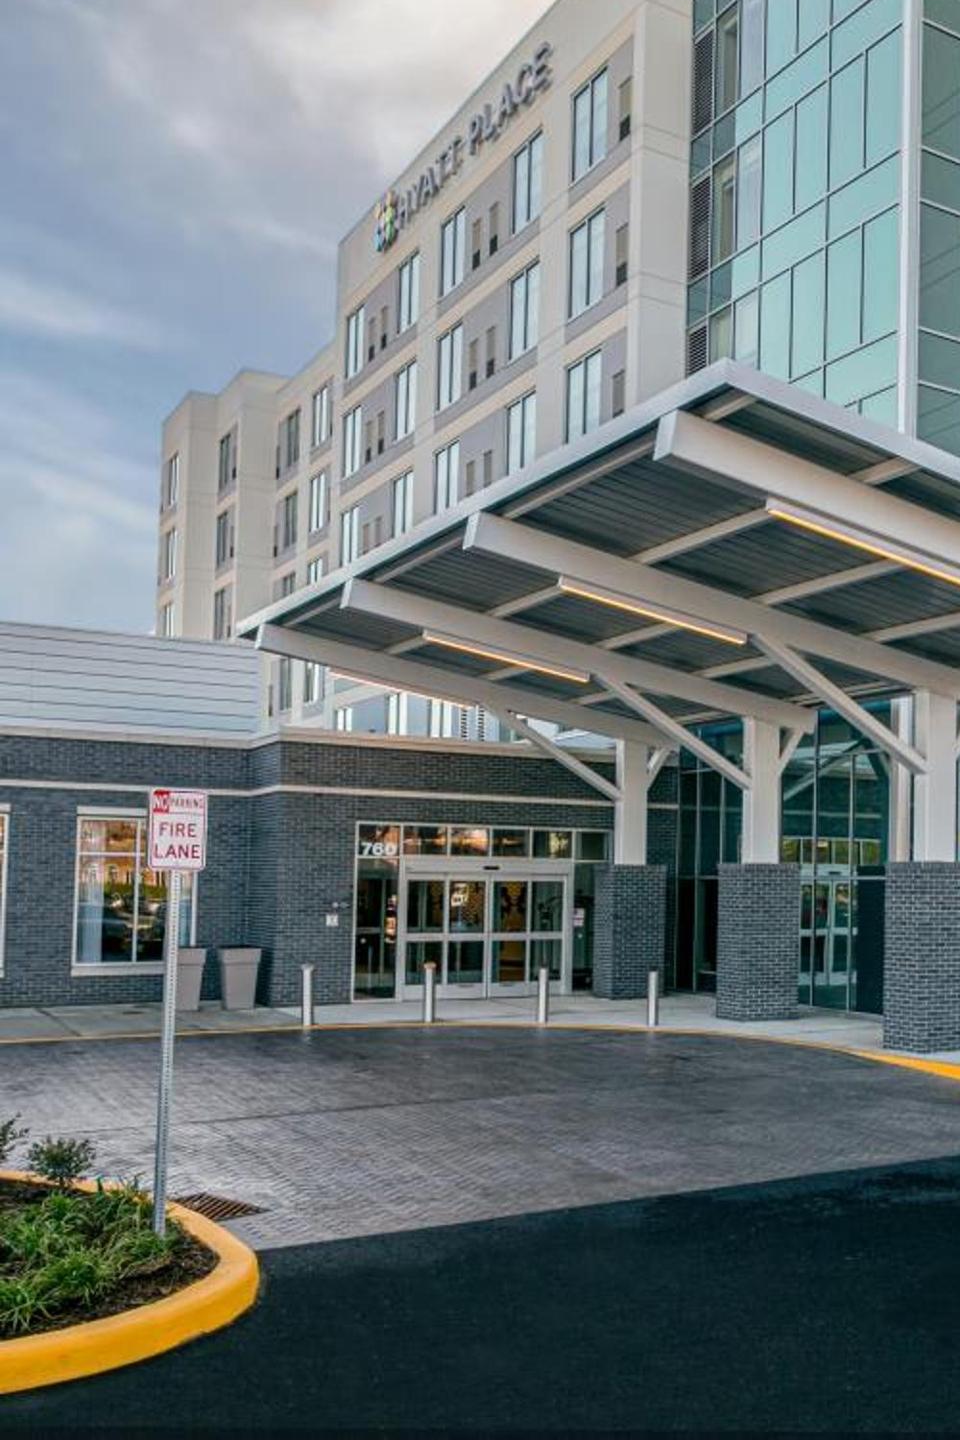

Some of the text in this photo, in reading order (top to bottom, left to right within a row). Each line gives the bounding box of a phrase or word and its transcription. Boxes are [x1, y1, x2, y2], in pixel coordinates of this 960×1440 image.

[399, 41, 553, 230] HYATT PLACE
[153, 793, 169, 810] NO
[159, 821, 198, 838] FIRE
[154, 843, 201, 859] LANE
[361, 842, 397, 856] 760
